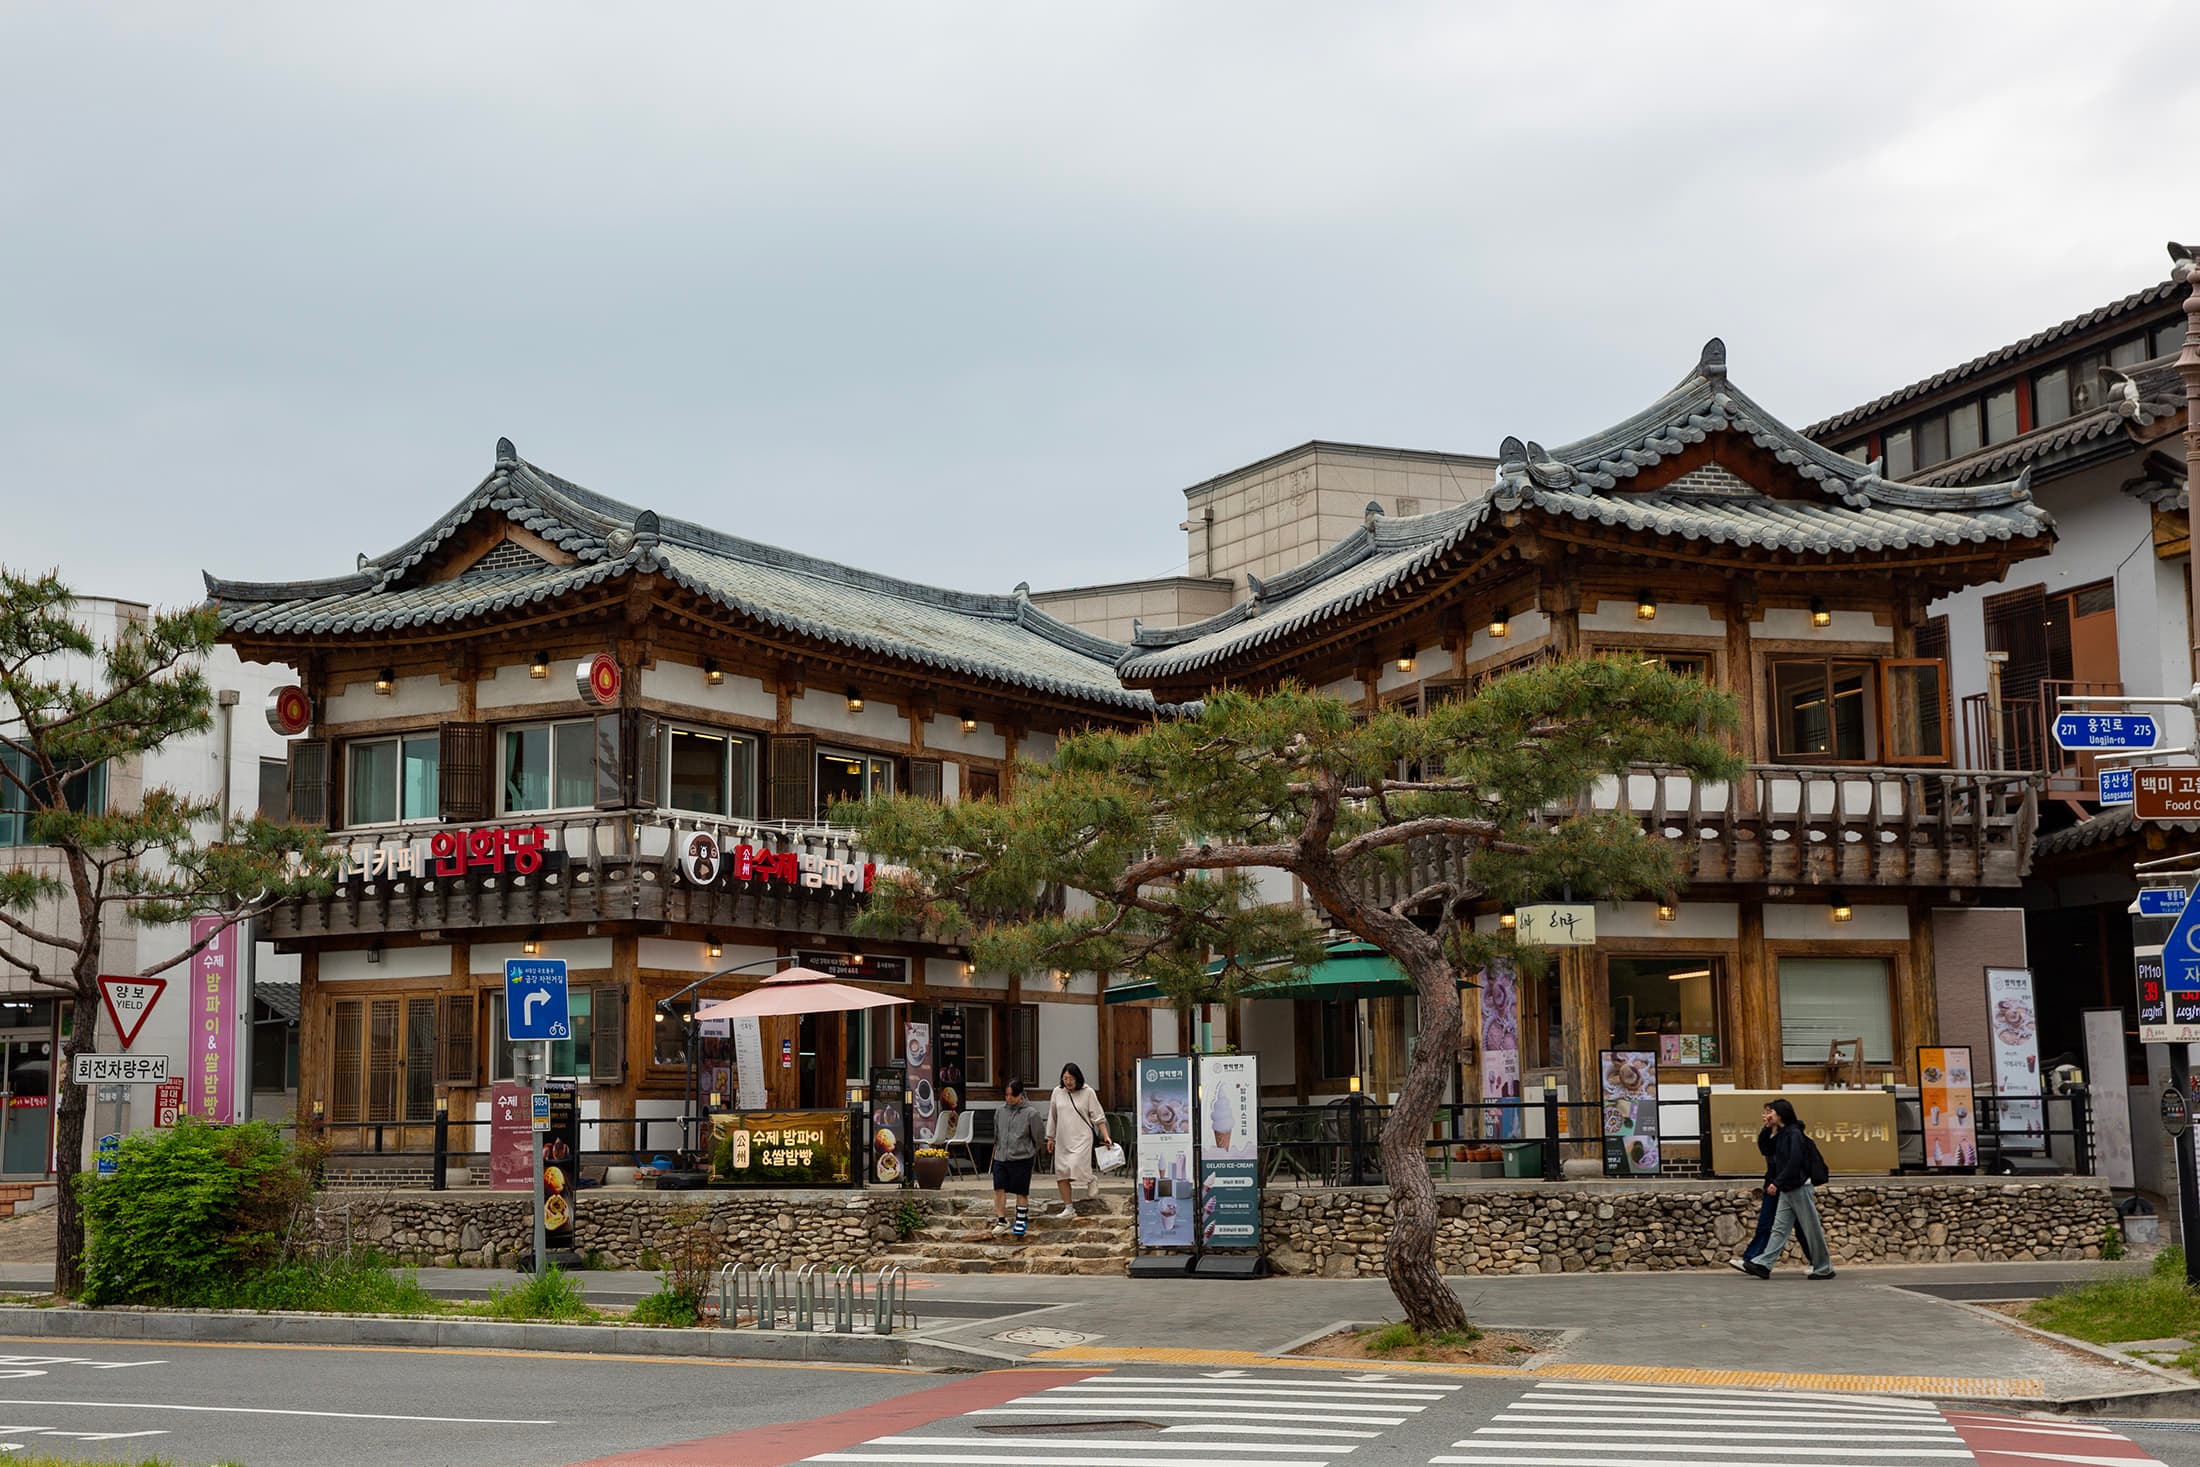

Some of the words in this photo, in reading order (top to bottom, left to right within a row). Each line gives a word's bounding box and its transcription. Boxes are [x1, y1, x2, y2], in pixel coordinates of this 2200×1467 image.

[2061, 724, 2077, 735] 271
[2133, 725, 2151, 736] 275
[2089, 735, 2126, 746] Ungjin-ro
[2141, 776, 2173, 794] 백미
[2165, 800, 2191, 811] Food
[431, 826, 550, 877] 인화당
[752, 847, 798, 885] 수제
[203, 954, 224, 968] 수제
[2138, 964, 2162, 979] PM10
[539, 975, 563, 984] 자전거길
[116, 999, 143, 1010] YIELD
[78, 1059, 165, 1080] 회전차량우선
[497, 1095, 518, 1108] 수제
[752, 1130, 779, 1146] 수제
[783, 1130, 824, 1146] 밤파이
[736, 1135, 746, 1163] 公州
[762, 1149, 814, 1167] &쌀밤빵
